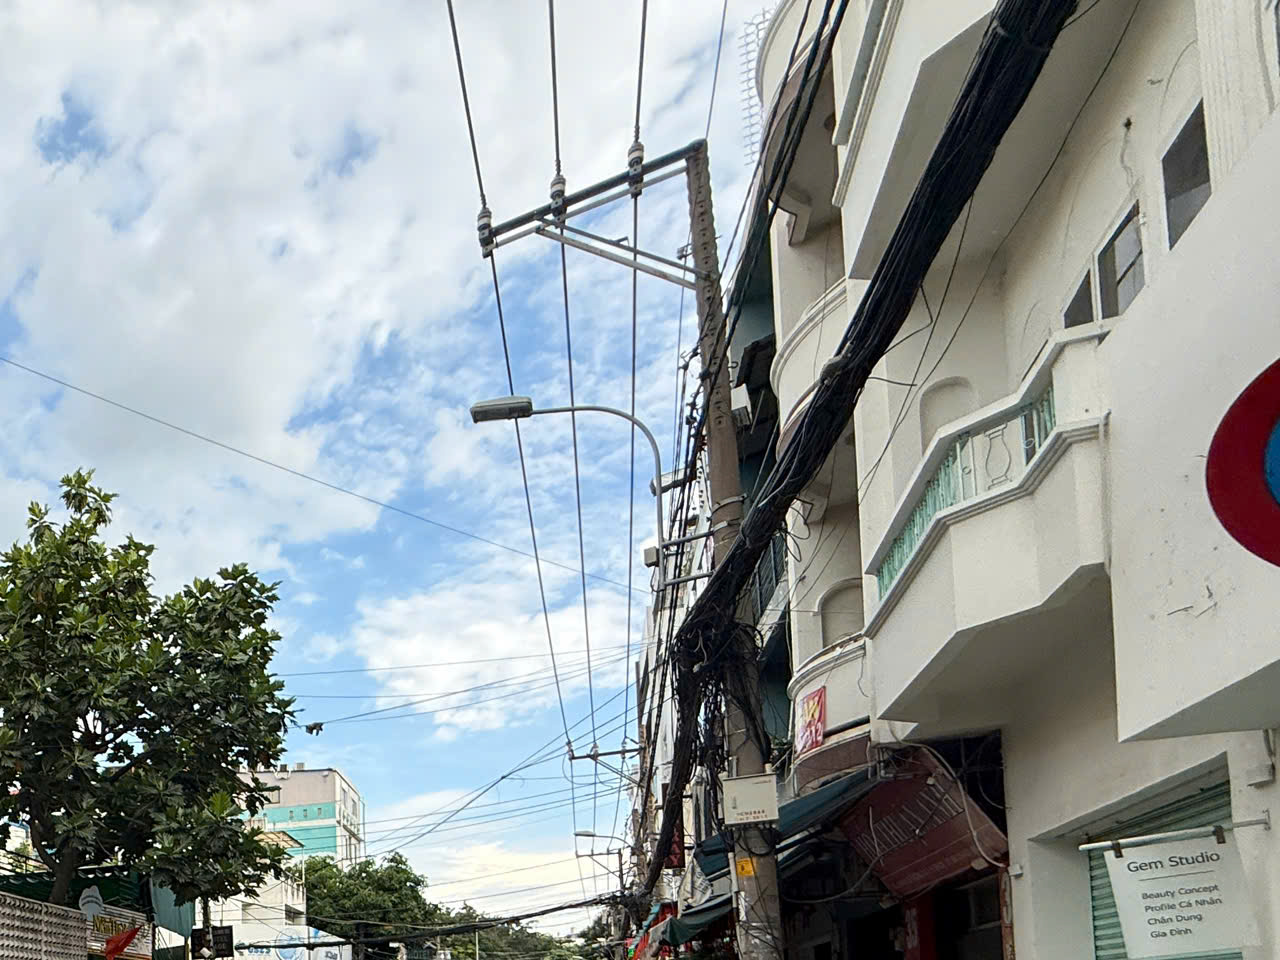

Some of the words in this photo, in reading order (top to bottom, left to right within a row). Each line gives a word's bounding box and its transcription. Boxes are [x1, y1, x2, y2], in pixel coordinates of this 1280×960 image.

[1127, 860, 1164, 872] Gem
[1168, 851, 1220, 868] Studio
[1141, 890, 1175, 900] Beauty
[1177, 884, 1219, 896] Concept
[1144, 902, 1176, 912] Profile
[1178, 900, 1192, 908] Cá
[1195, 897, 1223, 906] Nhân
[1175, 913, 1203, 922] Dung
[1150, 930, 1167, 938] Gia
[1169, 927, 1192, 936] Đình
